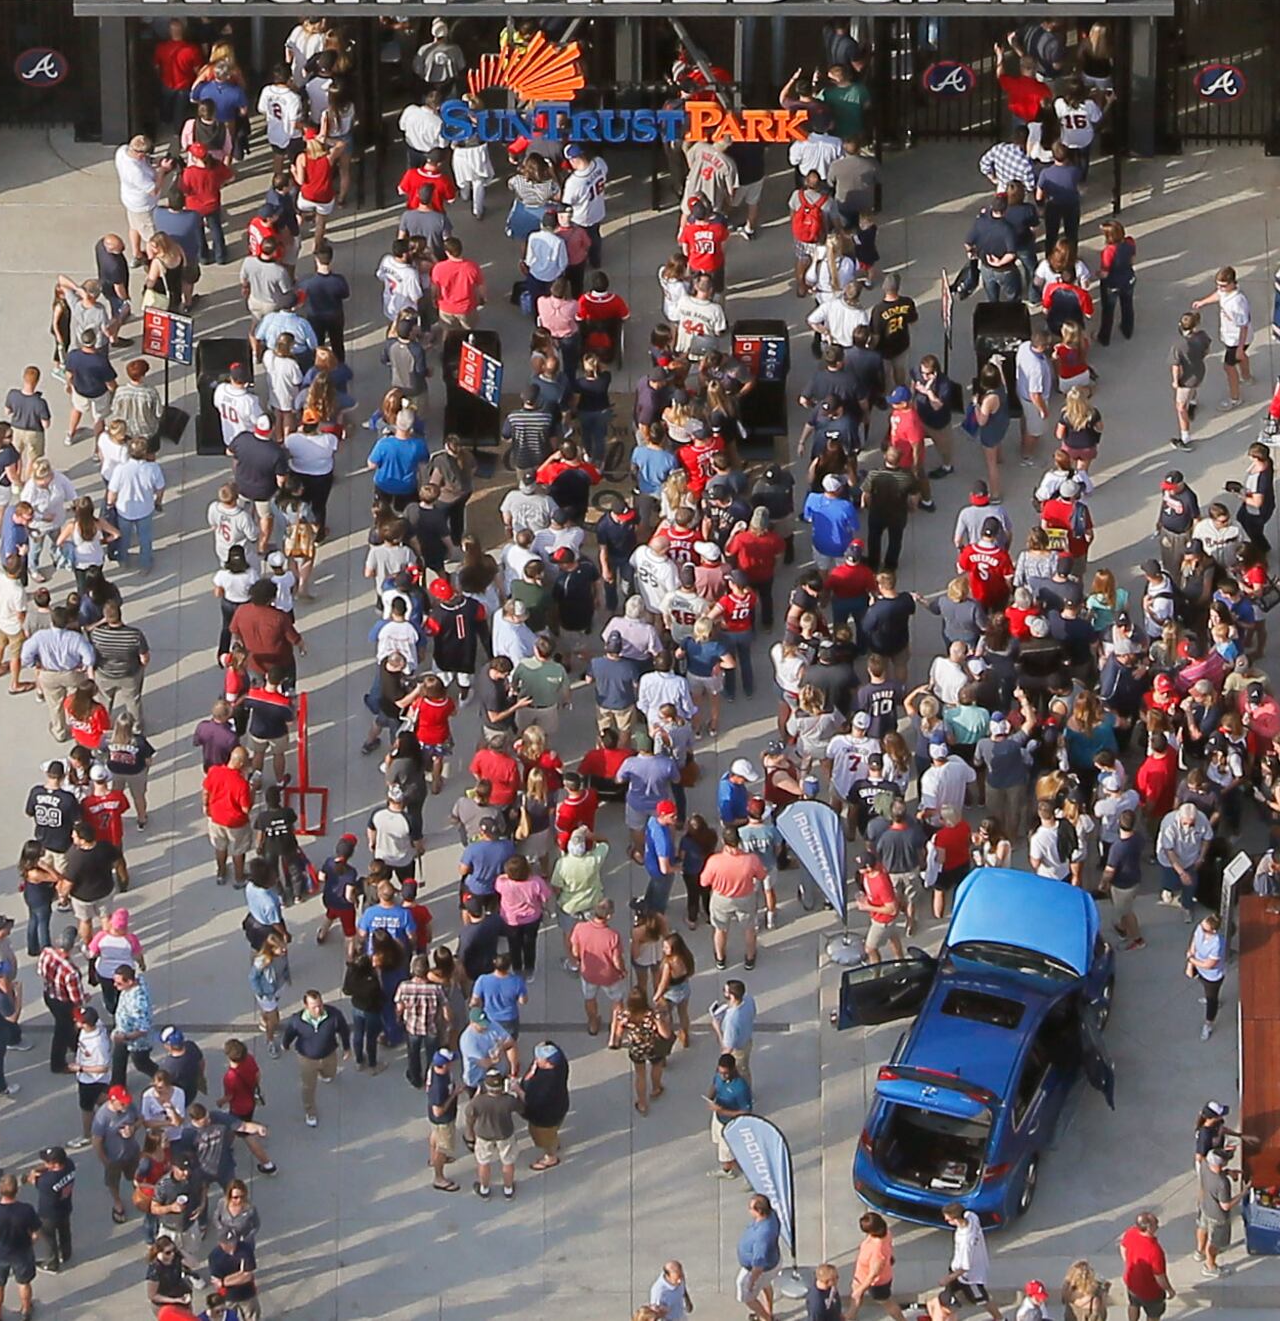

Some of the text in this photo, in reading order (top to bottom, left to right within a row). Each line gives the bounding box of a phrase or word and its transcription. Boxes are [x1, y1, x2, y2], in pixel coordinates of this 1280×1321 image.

[439, 99, 810, 144] SUNTRUST PARK
[701, 168, 714, 182] 4
[682, 319, 706, 336] 44
[888, 317, 904, 335] 21
[220, 402, 240, 424] 10
[977, 564, 990, 581] 5
[730, 608, 752, 621] 10
[871, 700, 893, 717] 10
[848, 753, 862, 772] 7
[34, 805, 63, 828] 29
